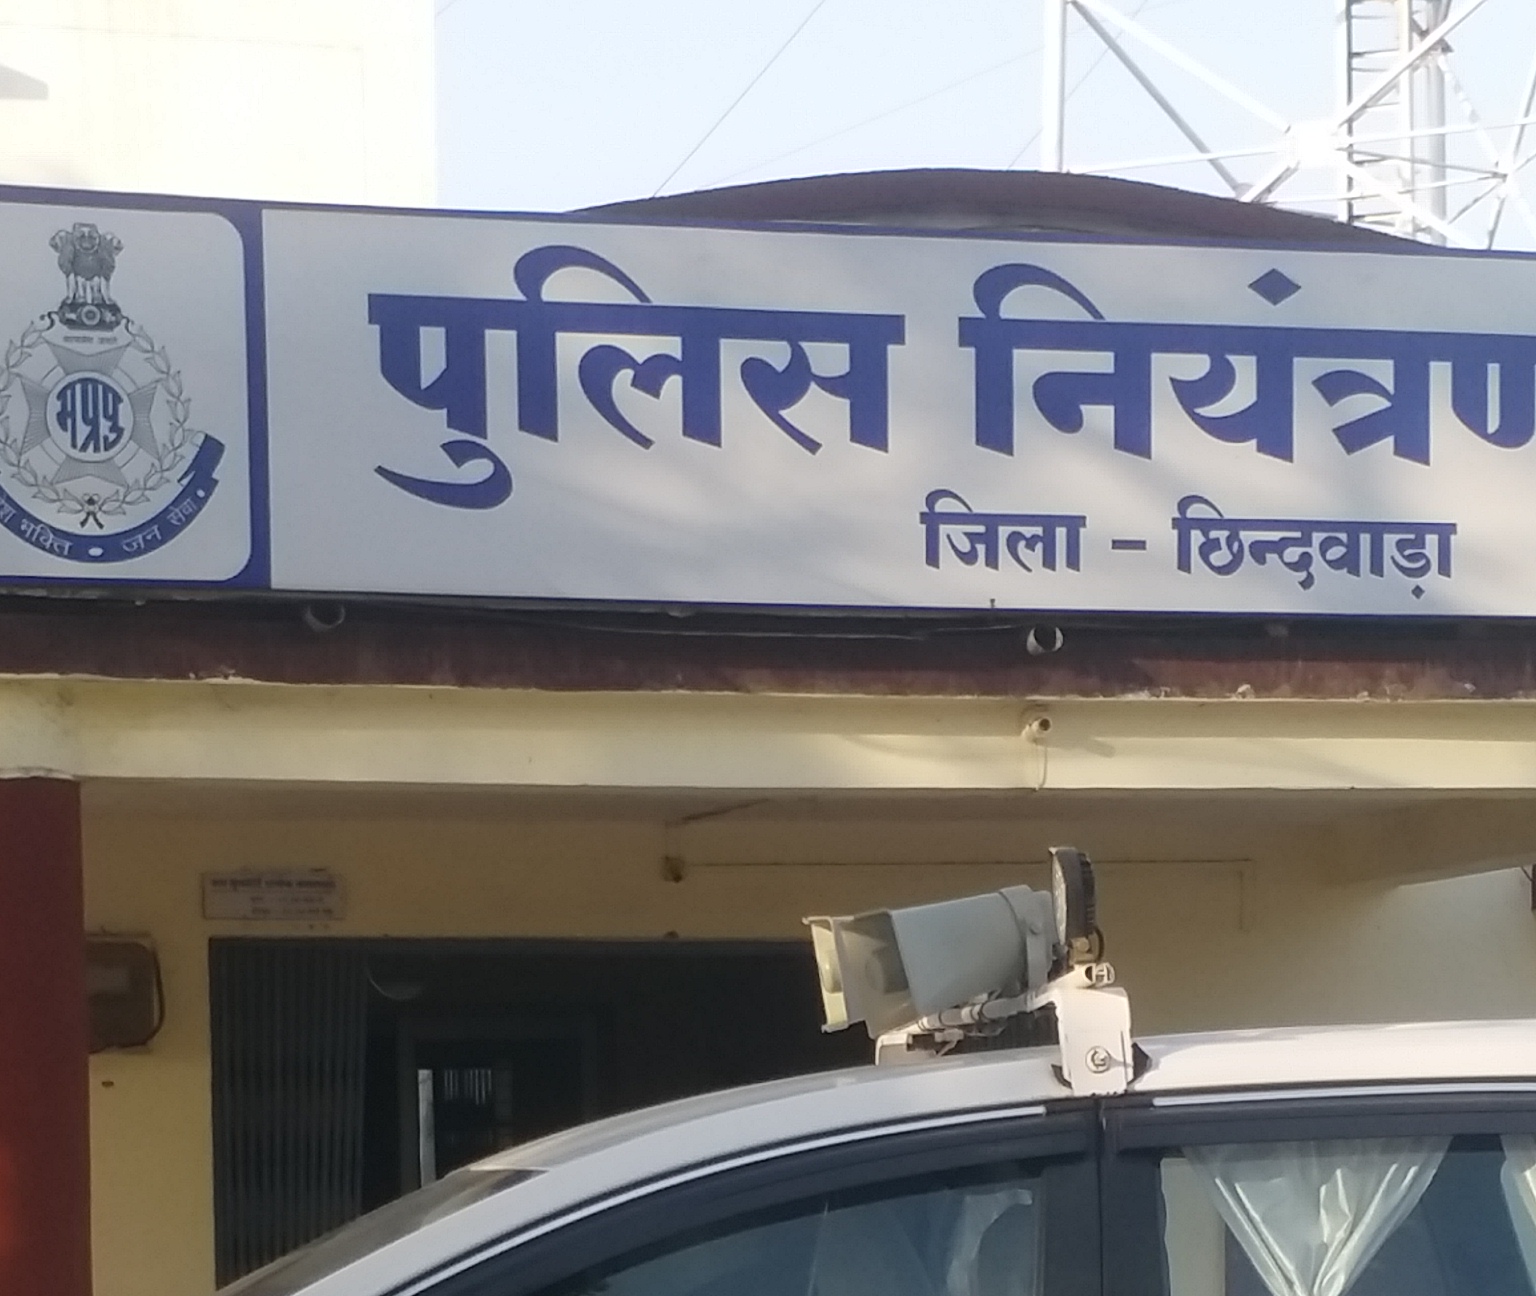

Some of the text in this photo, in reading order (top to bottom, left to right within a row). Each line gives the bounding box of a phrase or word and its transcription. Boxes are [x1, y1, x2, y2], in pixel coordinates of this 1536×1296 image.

[368, 244, 906, 510] पुलिस
[122, 524, 163, 553] जन
[166, 496, 199, 527] सेवा
[919, 490, 1087, 573] जिला
[1170, 494, 1458, 599] छिन्दवाड़ा
